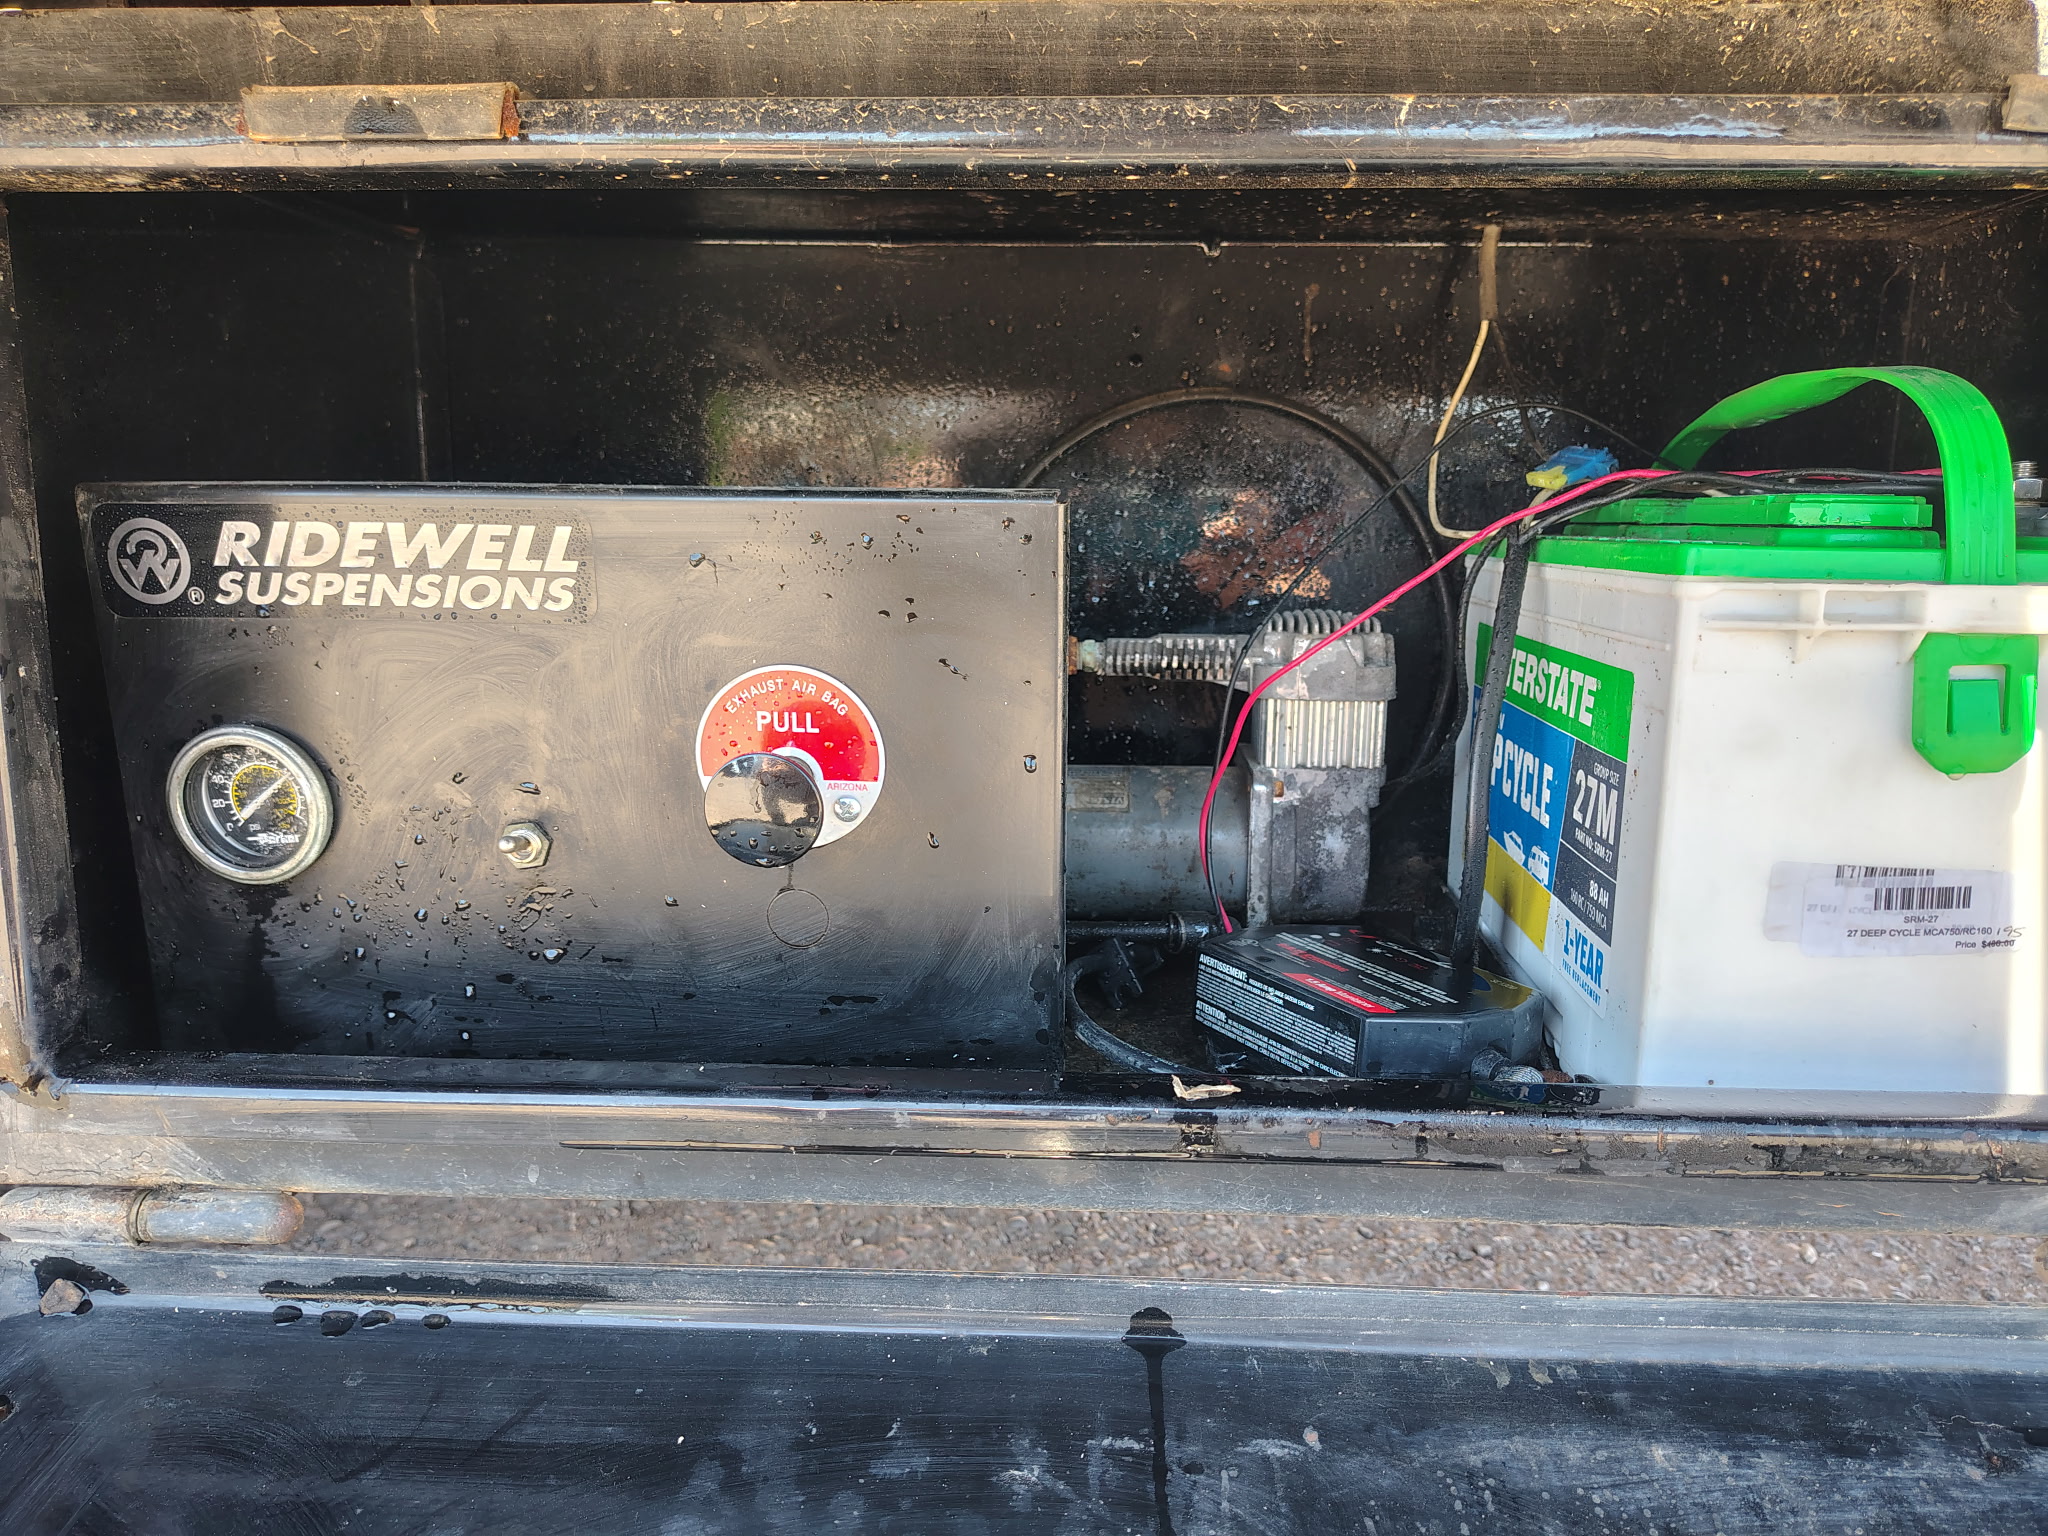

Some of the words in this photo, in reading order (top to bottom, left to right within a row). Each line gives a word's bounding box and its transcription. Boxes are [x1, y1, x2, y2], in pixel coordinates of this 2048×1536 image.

[213, 520, 580, 573] RIDEWELL
[214, 572, 577, 612] SUSPENSIONS
[725, 679, 784, 714] EXHAUST
[791, 680, 817, 696] AIR
[821, 690, 849, 716] BAG
[1505, 647, 1598, 728] TERSTATE
[756, 711, 820, 734] PULL
[827, 782, 868, 792] ARIZONA
[1593, 762, 1609, 780] GROUP
[1609, 770, 1620, 787] SIZE
[212, 798, 226, 809] 20
[1573, 769, 1618, 846] 27M
[1589, 879, 1599, 901] 88
[1598, 887, 1609, 910] AH
[1847, 929, 1858, 938] 27
[1860, 928, 1887, 938] DEEP
[1888, 928, 1921, 937] CYCLE
[1903, 915, 1939, 924] SRM-27
[1563, 918, 1605, 989] 1-YEAR
[1955, 940, 1977, 949] Price
[1199, 953, 1248, 982] AVERTISSEMENT:
[1562, 958, 1572, 976] FREE
[1572, 970, 1602, 1007] REPLACEMENT
[1196, 1000, 1227, 1023] ATTENTION:
